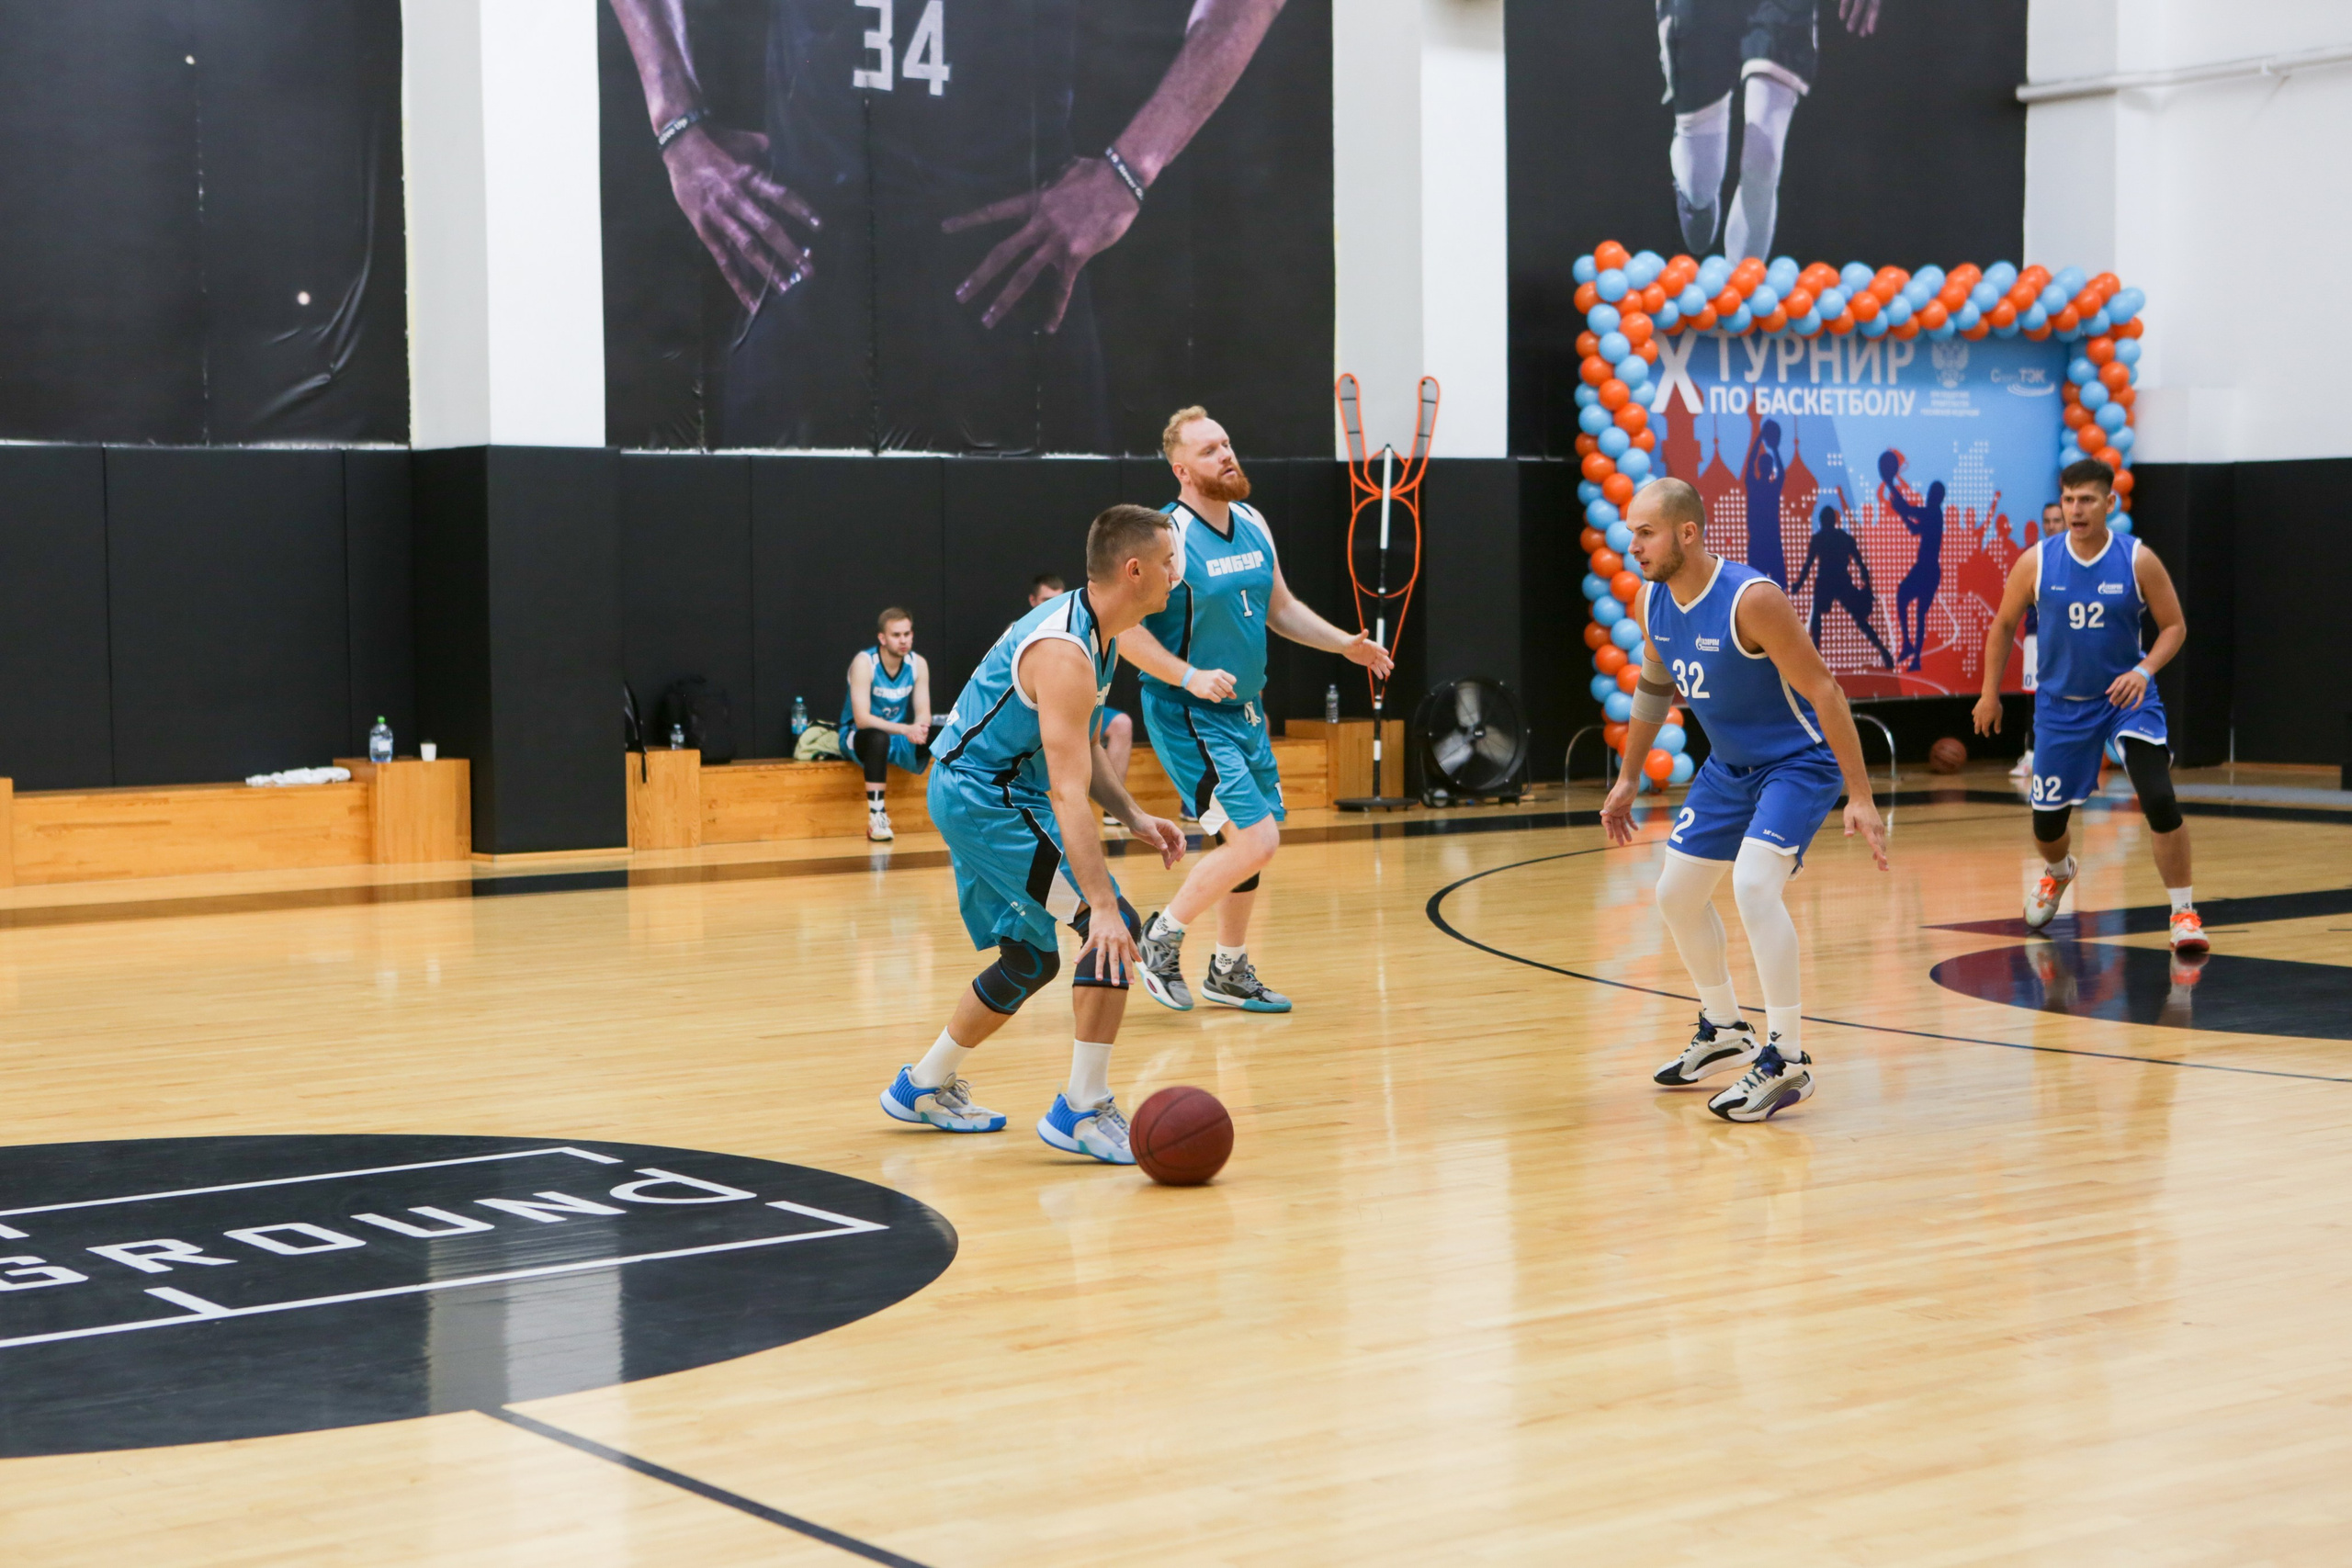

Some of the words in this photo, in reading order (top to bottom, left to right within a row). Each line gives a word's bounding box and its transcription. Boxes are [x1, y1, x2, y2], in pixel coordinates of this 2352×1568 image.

[854, 0, 950, 96] 34
[1712, 329, 1915, 385] ТУРНИР
[1710, 386, 1747, 413] ПО
[1755, 387, 1916, 417] БАСКЕТБОЛУ
[1206, 550, 1264, 578] СИБУР
[1240, 589, 1253, 617] 1
[2068, 602, 2105, 630] 92
[1672, 659, 1710, 698] 32
[2032, 774, 2063, 802] 92
[1670, 807, 1695, 844] 2
